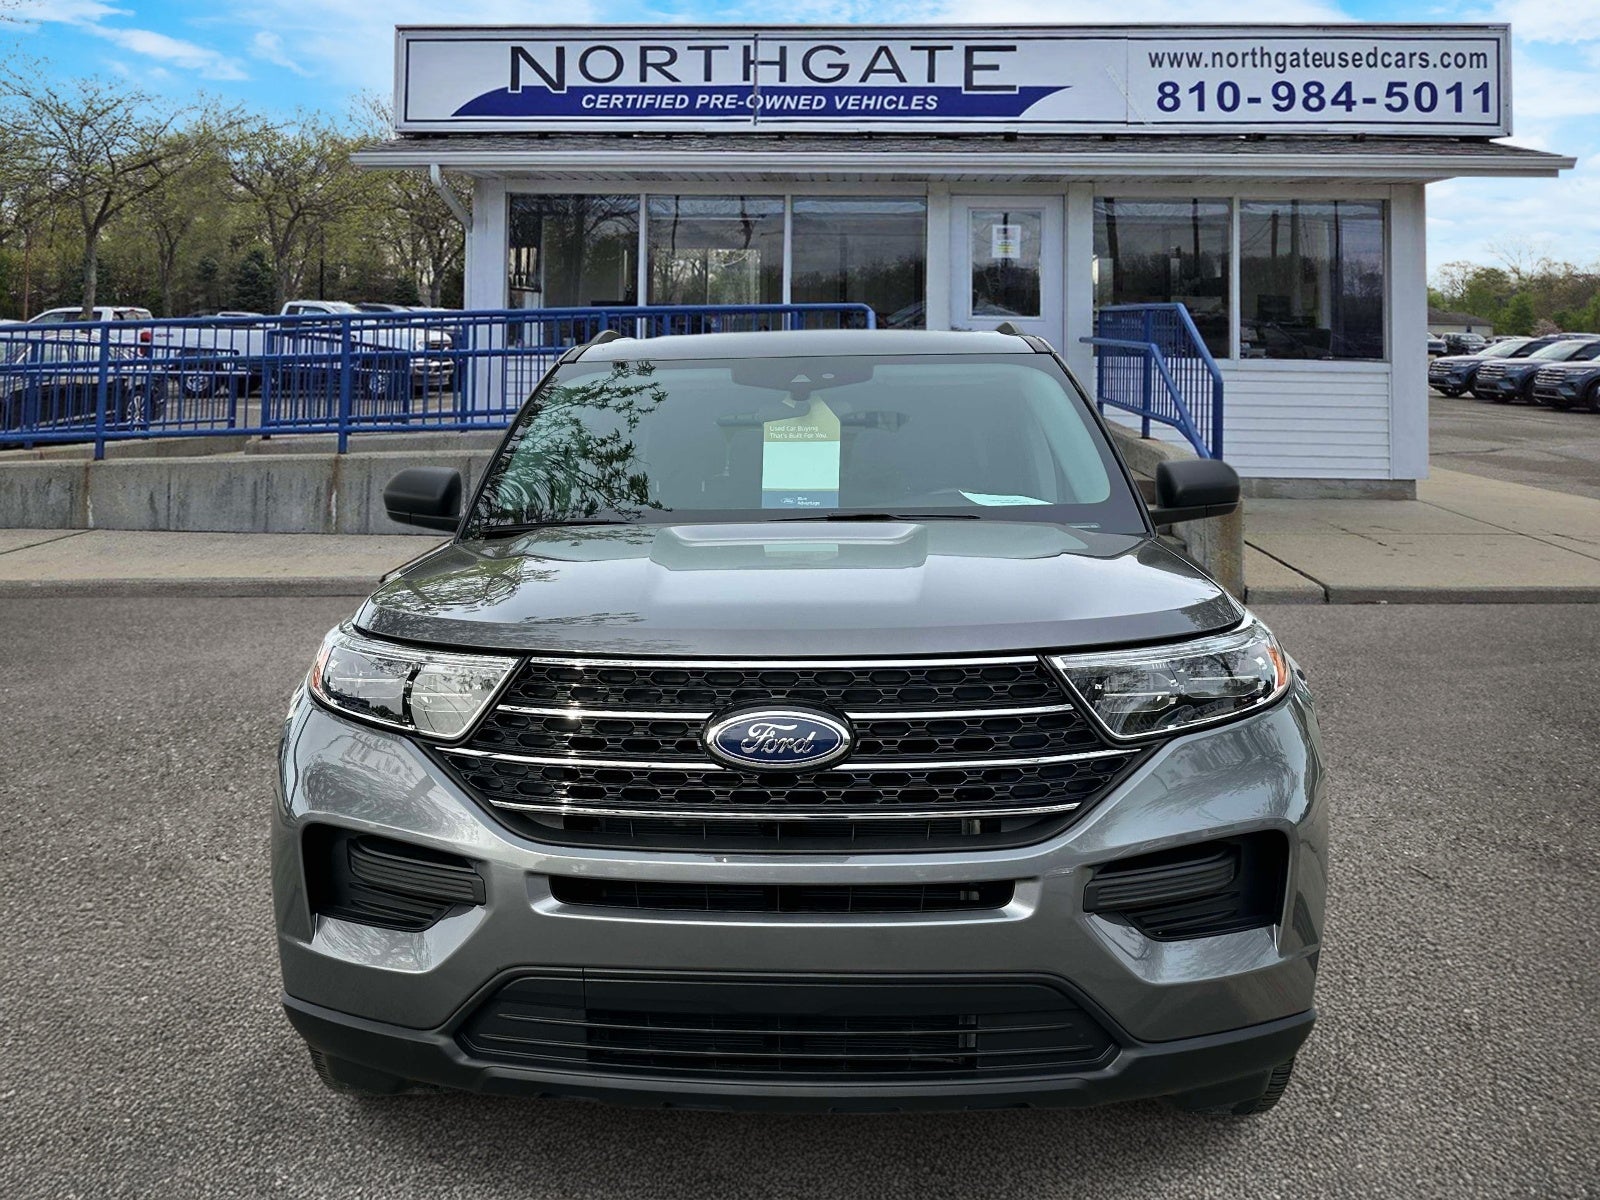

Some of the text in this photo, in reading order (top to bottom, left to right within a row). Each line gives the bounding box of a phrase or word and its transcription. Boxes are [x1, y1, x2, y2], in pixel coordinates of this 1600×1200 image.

[510, 45, 1017, 92] NORTHGATE
[1149, 47, 1488, 73] www.northgateusedcars.com
[581, 94, 938, 111] CERTIFIED PRE-OWNED VEHICLES
[1156, 81, 1491, 114] 810-984-5011
[797, 425, 819, 433] Buying
[740, 722, 817, 754] Ford
